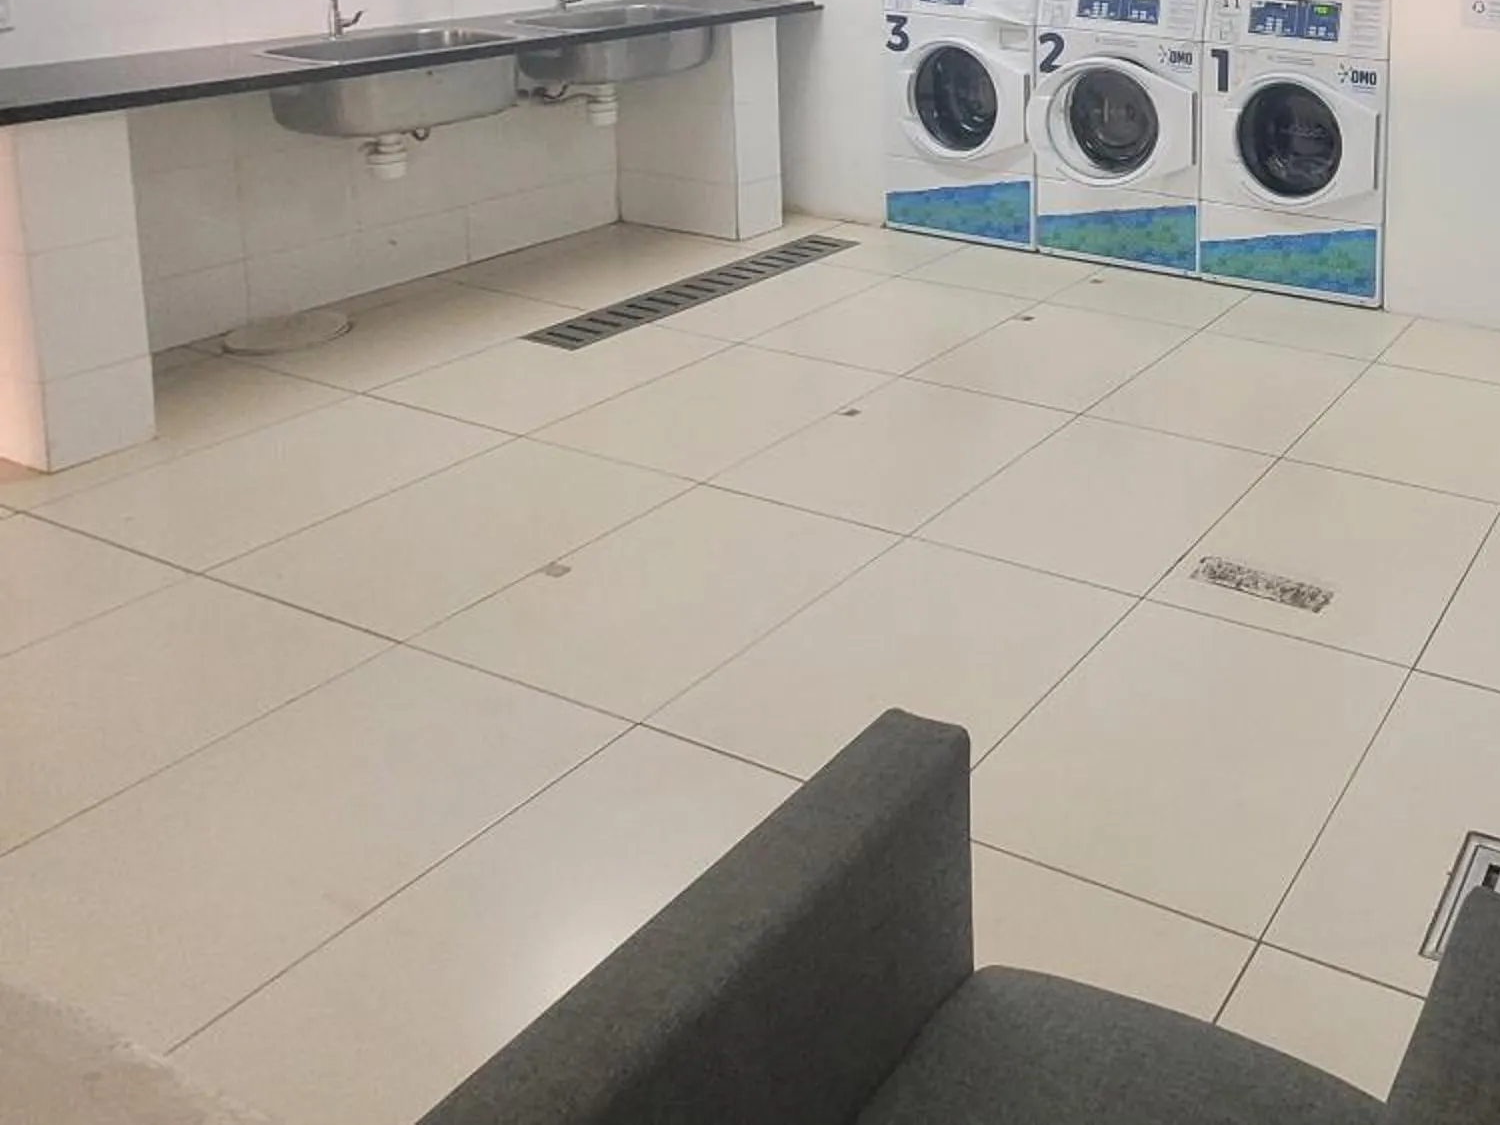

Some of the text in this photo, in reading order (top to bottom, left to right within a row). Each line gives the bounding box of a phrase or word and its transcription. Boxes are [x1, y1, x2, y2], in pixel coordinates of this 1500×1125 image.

[886, 14, 910, 52] 3
[1038, 32, 1065, 74] 2
[1168, 50, 1194, 66] OMO
[1210, 48, 1230, 93] 1
[1351, 69, 1378, 86] OMO
